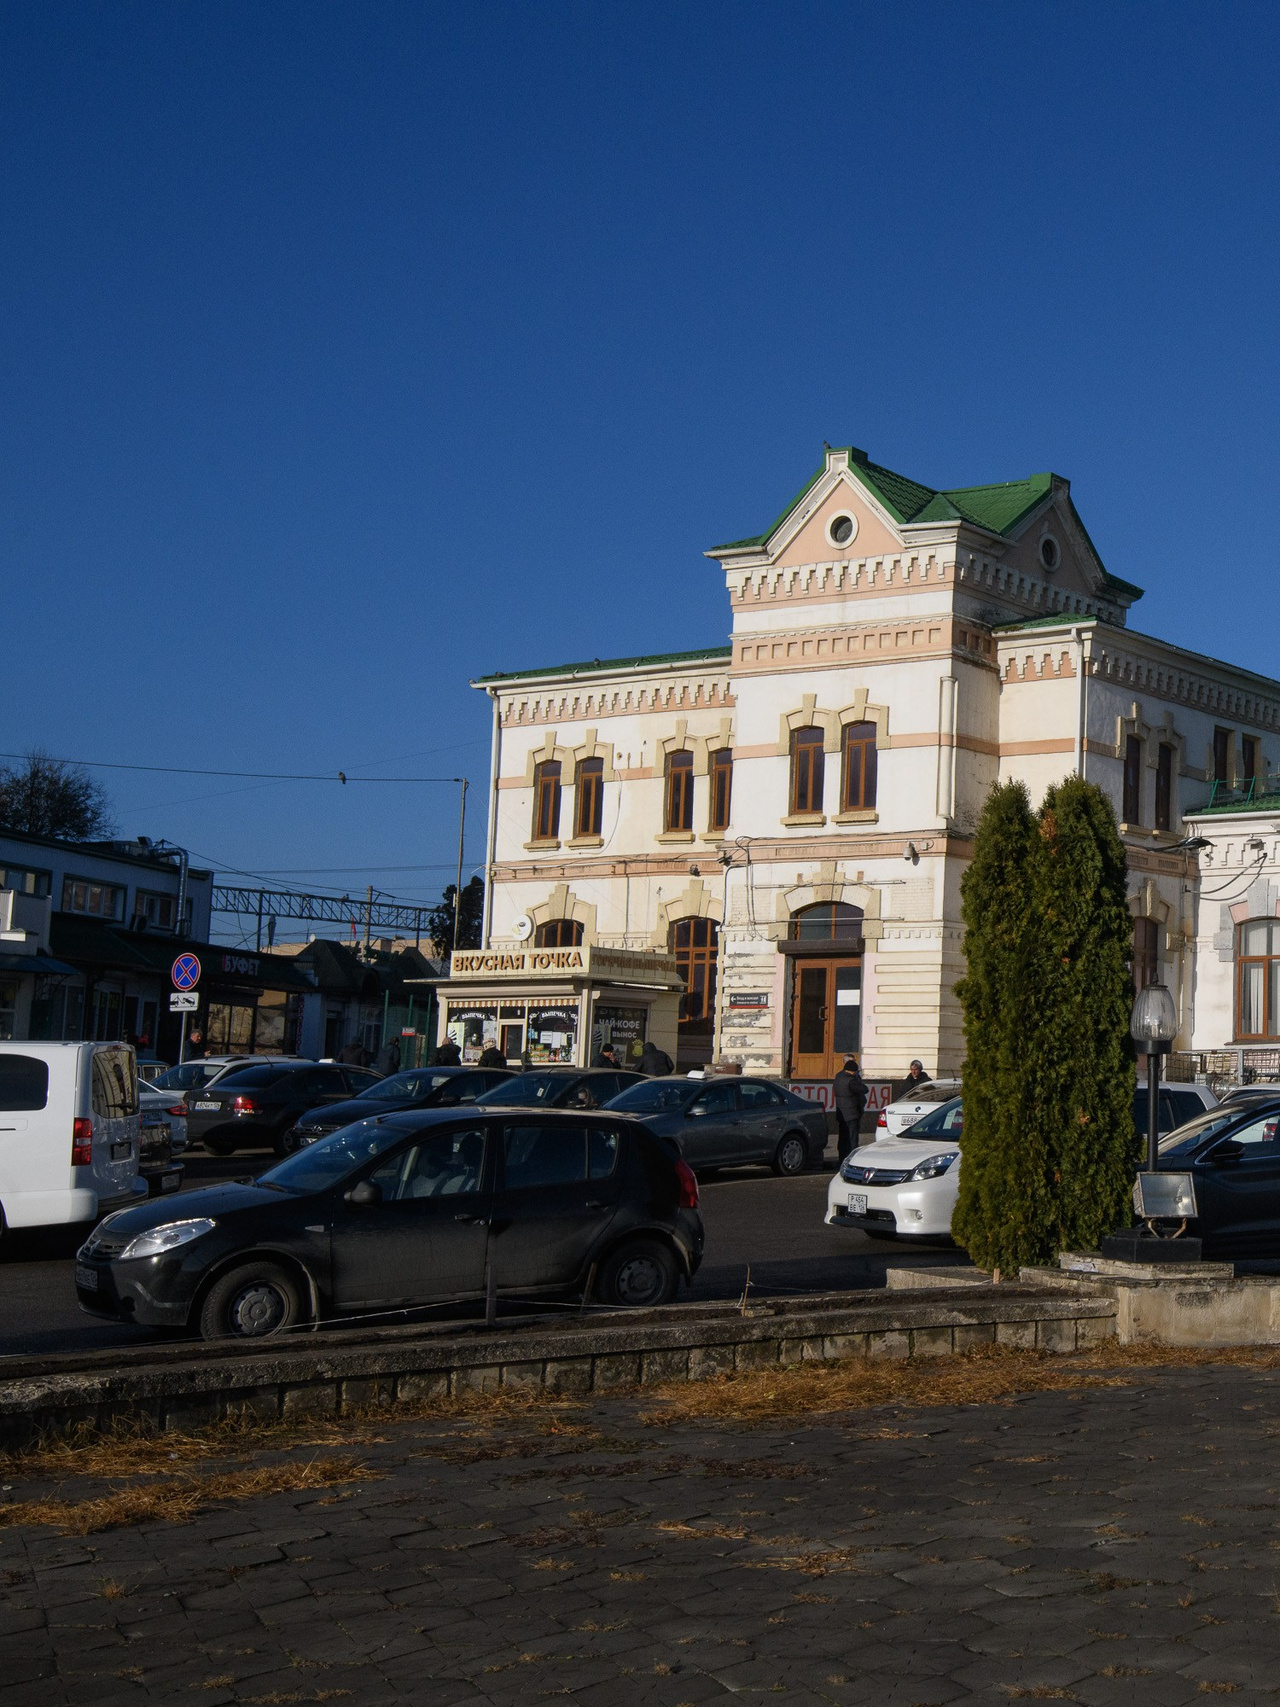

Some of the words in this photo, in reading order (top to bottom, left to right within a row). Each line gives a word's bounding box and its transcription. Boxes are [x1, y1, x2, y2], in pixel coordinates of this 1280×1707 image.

[223, 955, 260, 976] БУФЕТ
[453, 954, 525, 971] ВКУСНАЯ
[529, 952, 583, 969] ТОЧКА
